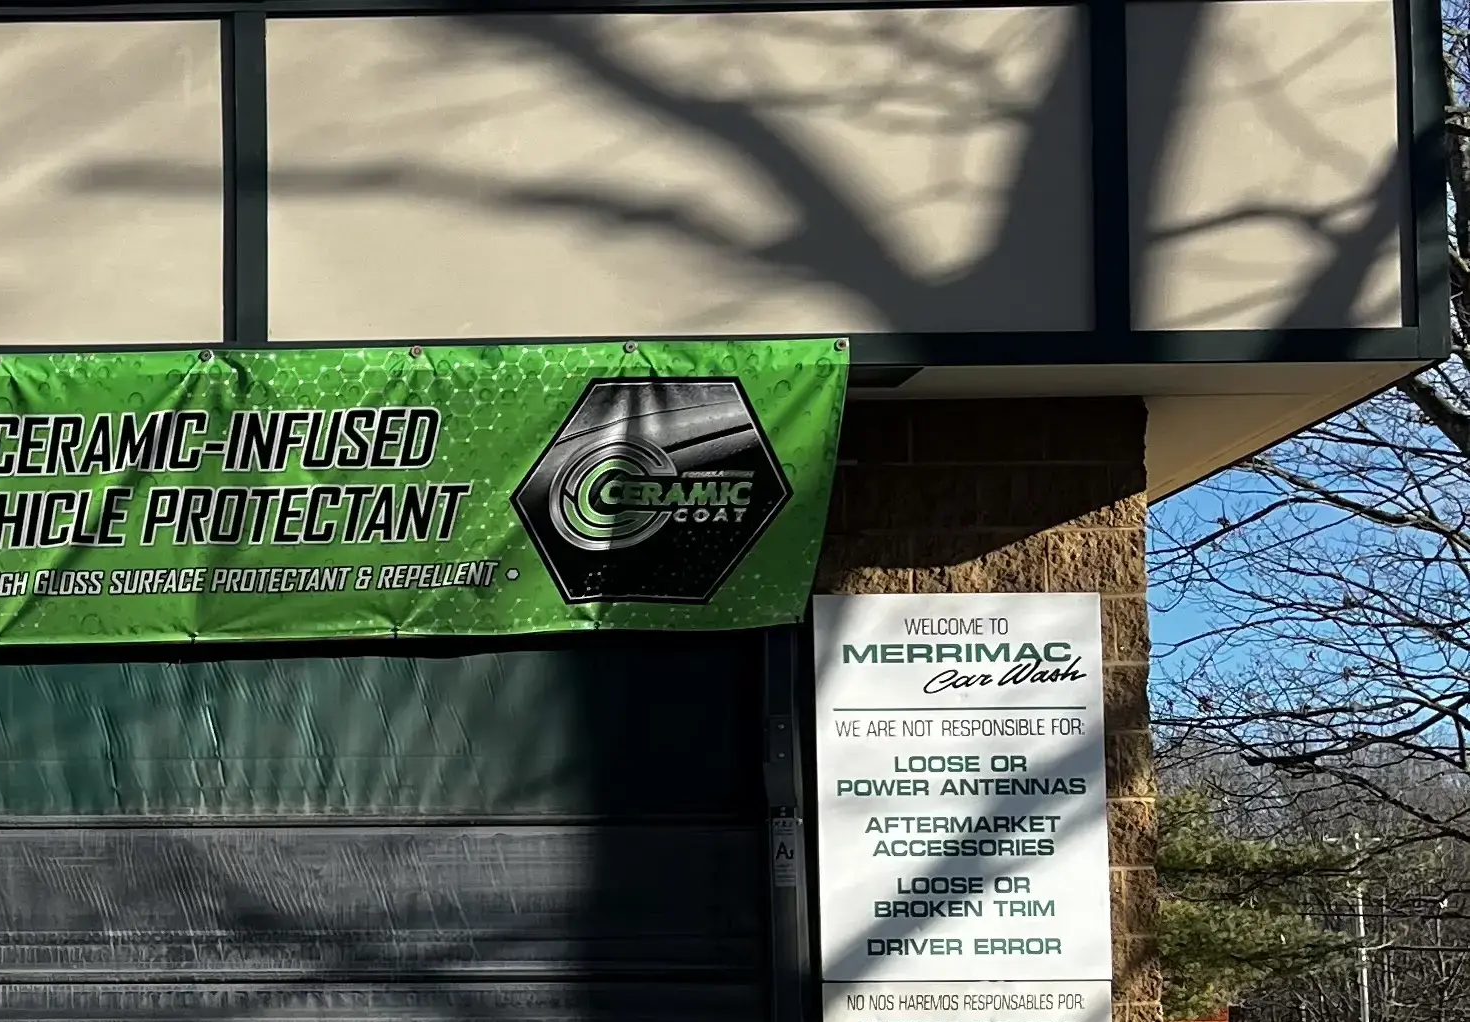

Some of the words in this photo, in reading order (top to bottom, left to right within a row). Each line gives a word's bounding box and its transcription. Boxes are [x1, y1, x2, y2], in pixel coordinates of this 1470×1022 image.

[600, 480, 753, 506] CERAMIC
[140, 484, 472, 547] PROTECTANT
[673, 508, 747, 522] COAT
[34, 570, 103, 596] GLOSS
[108, 568, 212, 595] SURFACE
[212, 566, 351, 594] PROTECTANT
[355, 568, 372, 590] &
[377, 561, 498, 590] REPELLENT
[904, 618, 982, 635] WELCOME
[990, 618, 1008, 634] TO
[842, 642, 1072, 664] MERRIMAC
[924, 670, 993, 694] Car
[998, 656, 1087, 685] Wash
[836, 720, 861, 737] WE
[867, 720, 897, 737] ARE
[902, 720, 933, 737] NOT
[942, 719, 1045, 737] RESPONSIBLE
[1052, 719, 1085, 735] FOR:
[894, 756, 980, 772] LOOSE
[991, 756, 1027, 772] OR
[837, 780, 929, 796] POWER
[940, 778, 1086, 795] ANTENNAS
[865, 816, 1060, 833] AFTERMARKET
[873, 839, 1055, 857] ACCESSORIES
[897, 877, 983, 894] LOOSE
[994, 877, 1030, 893] OR
[874, 901, 982, 918] BROKEN
[994, 900, 1055, 917] TRIM
[867, 939, 962, 956] DRIVER
[974, 938, 1062, 955] ERROR
[847, 995, 864, 1011] NO
[869, 995, 894, 1011] NOS
[899, 995, 959, 1011] HAREMOS
[964, 994, 1053, 1010] RESPONSABLES
